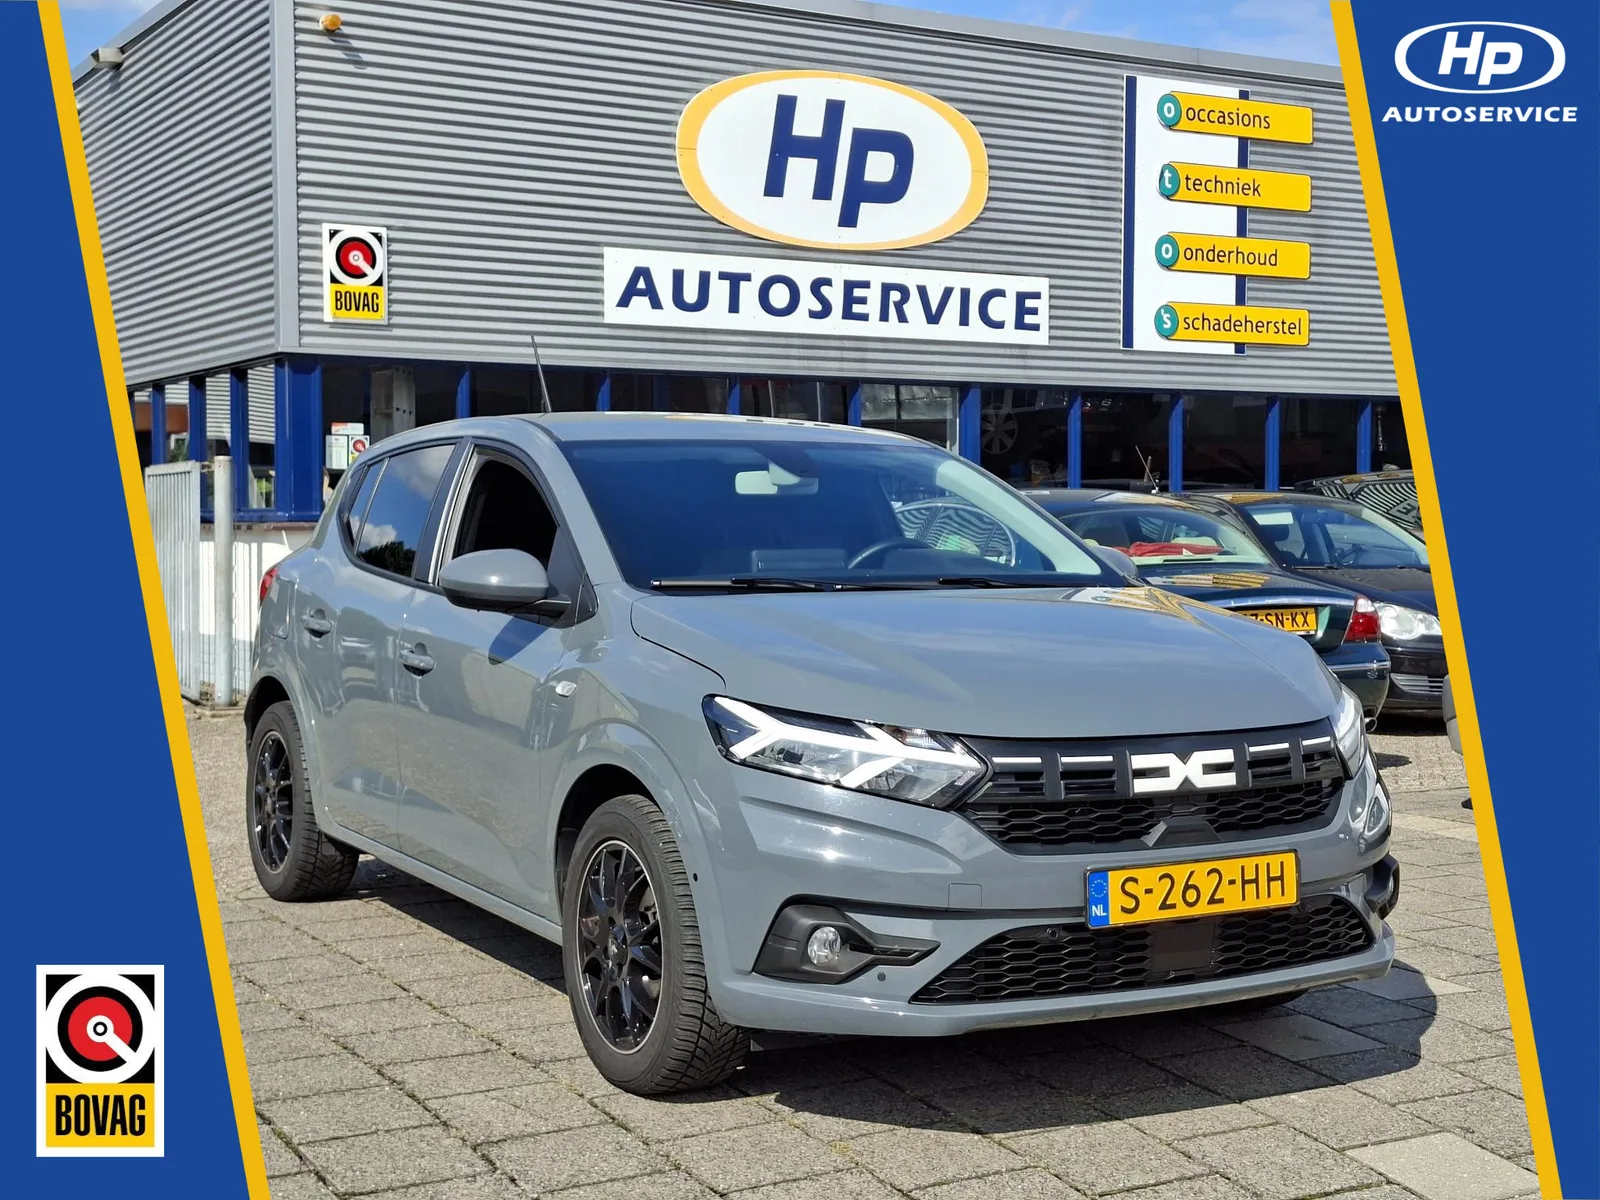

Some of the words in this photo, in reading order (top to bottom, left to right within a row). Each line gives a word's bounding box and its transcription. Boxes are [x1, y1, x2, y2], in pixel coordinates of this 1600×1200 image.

[1185, 106, 1271, 129] occasions
[1184, 174, 1262, 197] techniek
[1183, 245, 1278, 267] onderhoud
[334, 290, 379, 313] BOVAG
[616, 266, 1042, 332] AUTOSERVICE
[1183, 313, 1302, 335] schadeherstel
[1091, 905, 1107, 916] NL
[1120, 860, 1286, 915] S-262-HH
